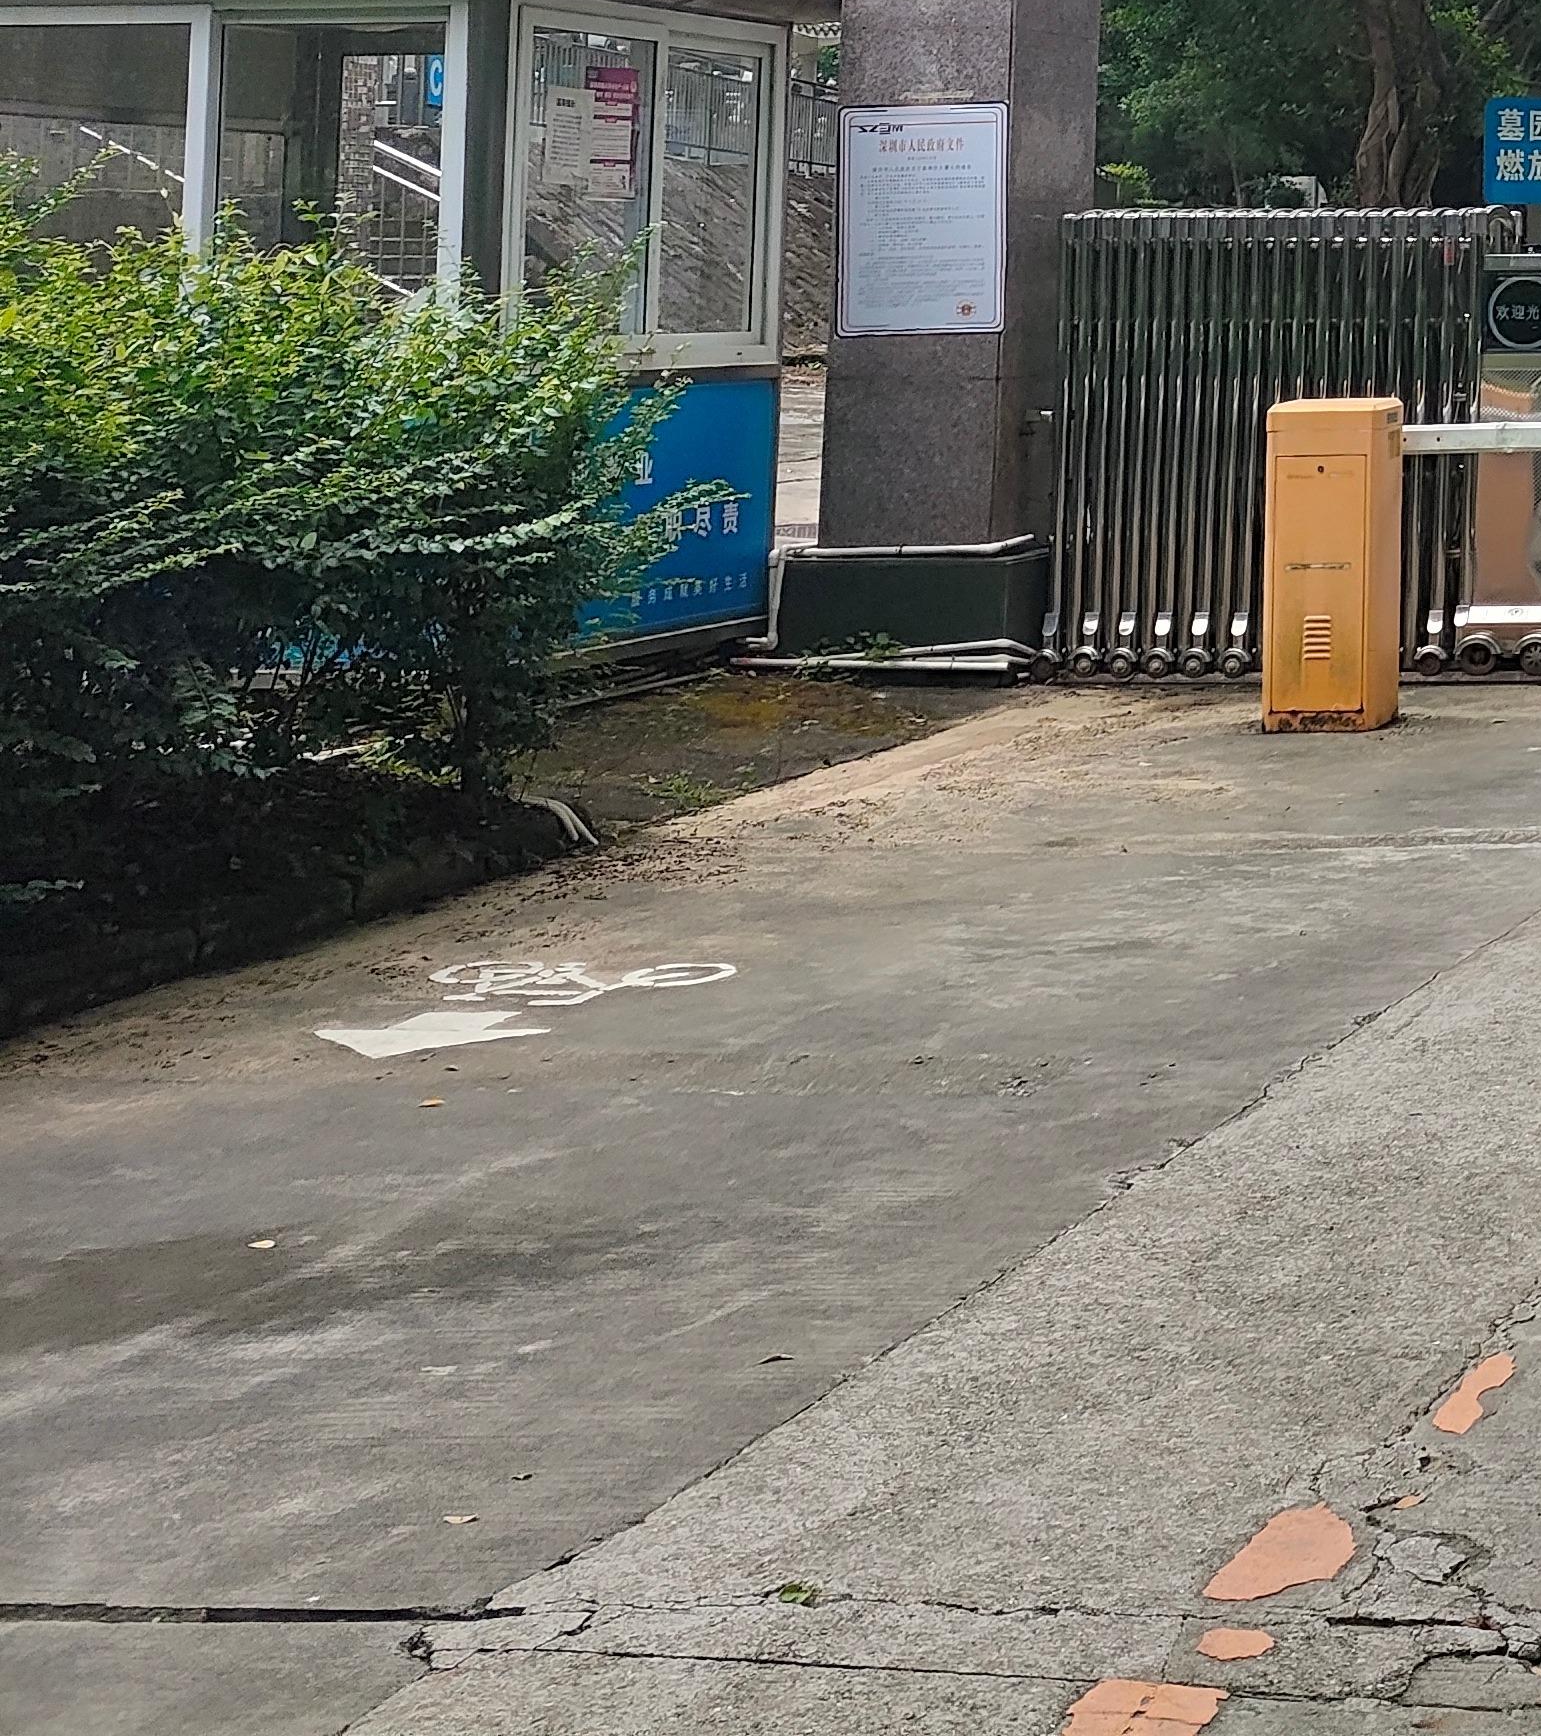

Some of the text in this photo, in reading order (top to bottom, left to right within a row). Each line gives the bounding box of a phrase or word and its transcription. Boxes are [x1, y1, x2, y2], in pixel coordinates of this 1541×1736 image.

[879, 137, 965, 153] 深圳市人民政府文件
